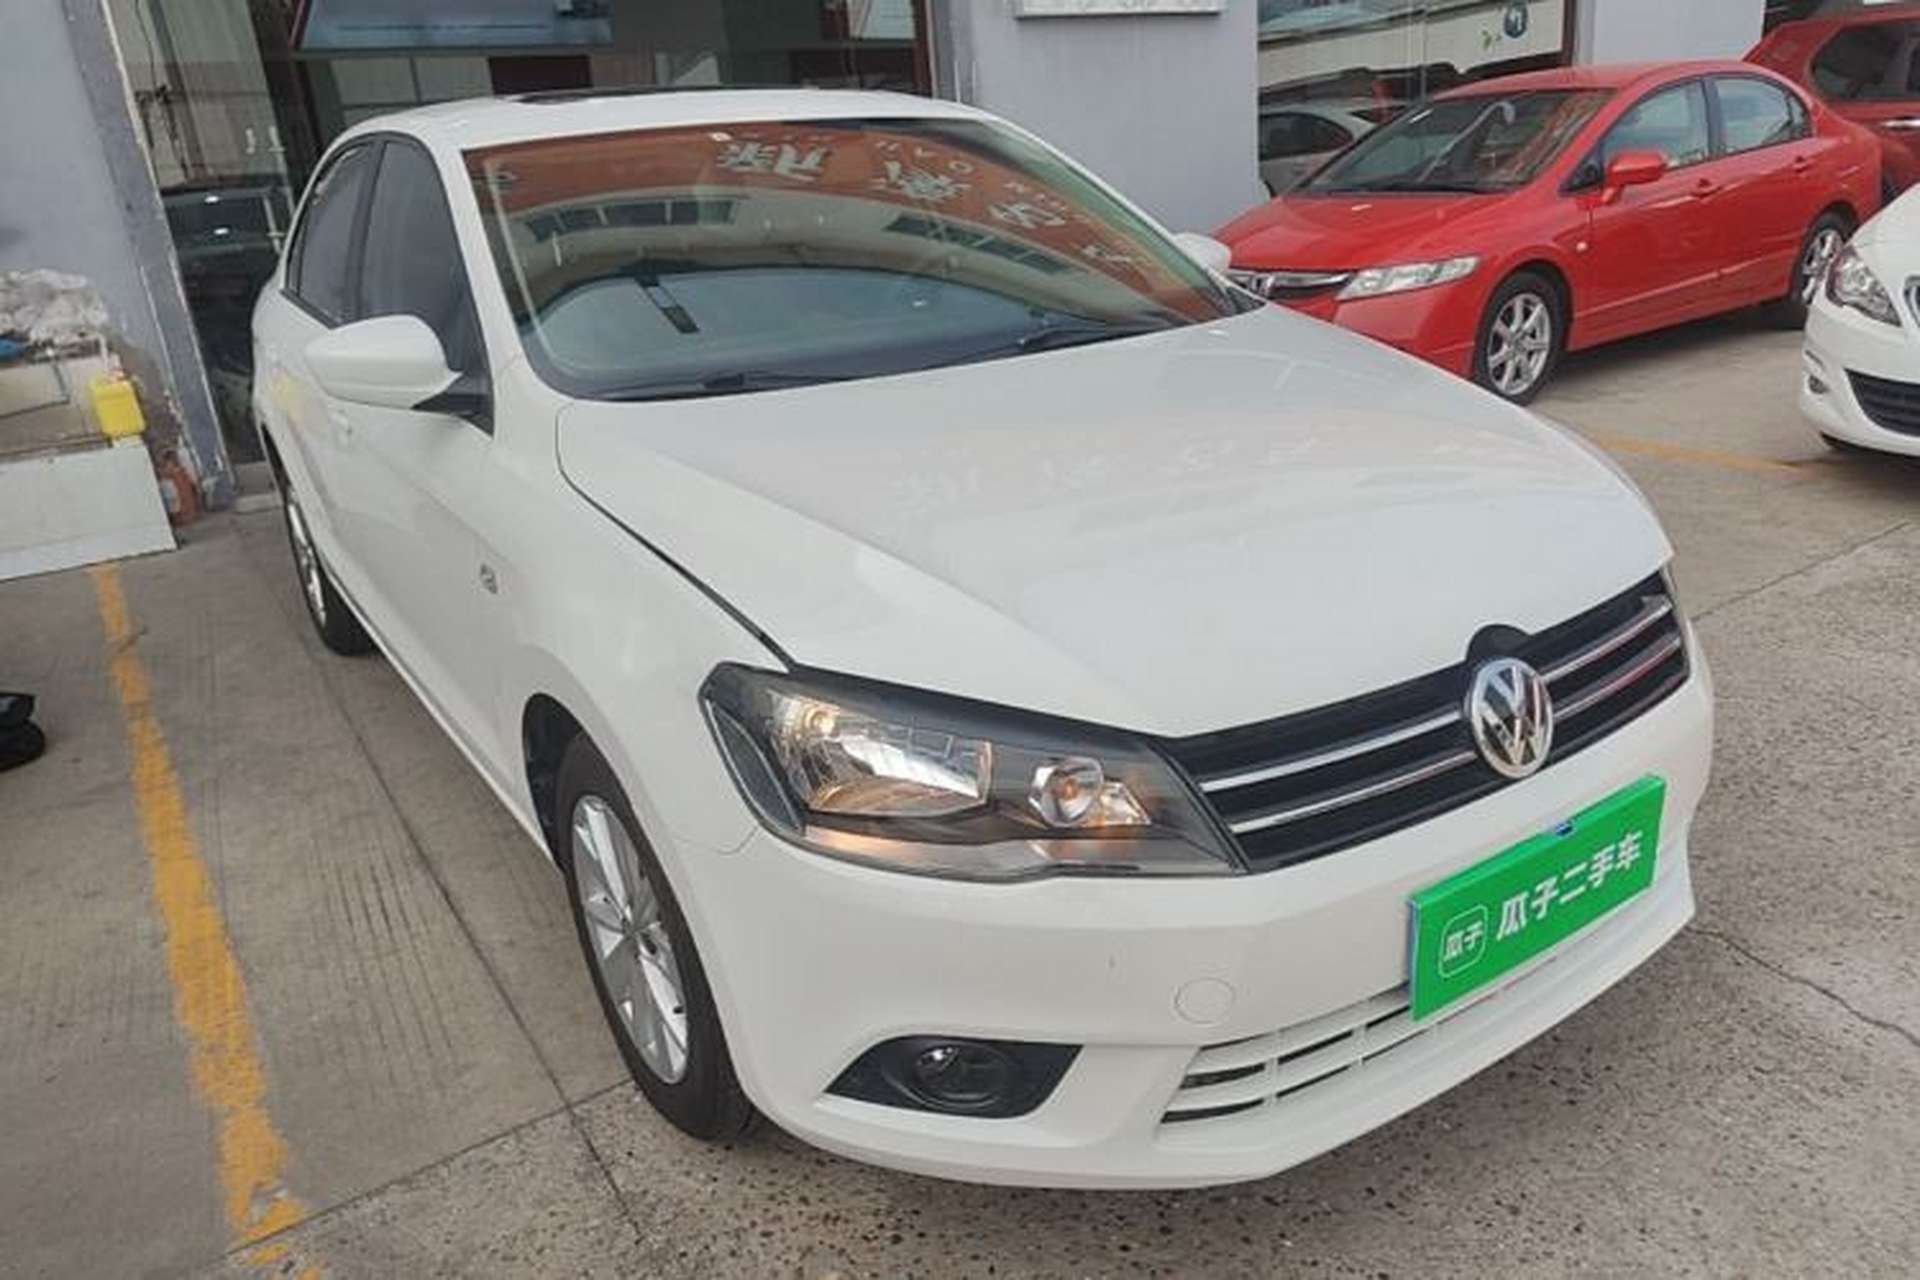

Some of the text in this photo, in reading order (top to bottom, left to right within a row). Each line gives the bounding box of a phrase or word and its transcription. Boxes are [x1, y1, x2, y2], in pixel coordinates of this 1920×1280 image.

[1496, 830, 1643, 941] 瓜子二手车
